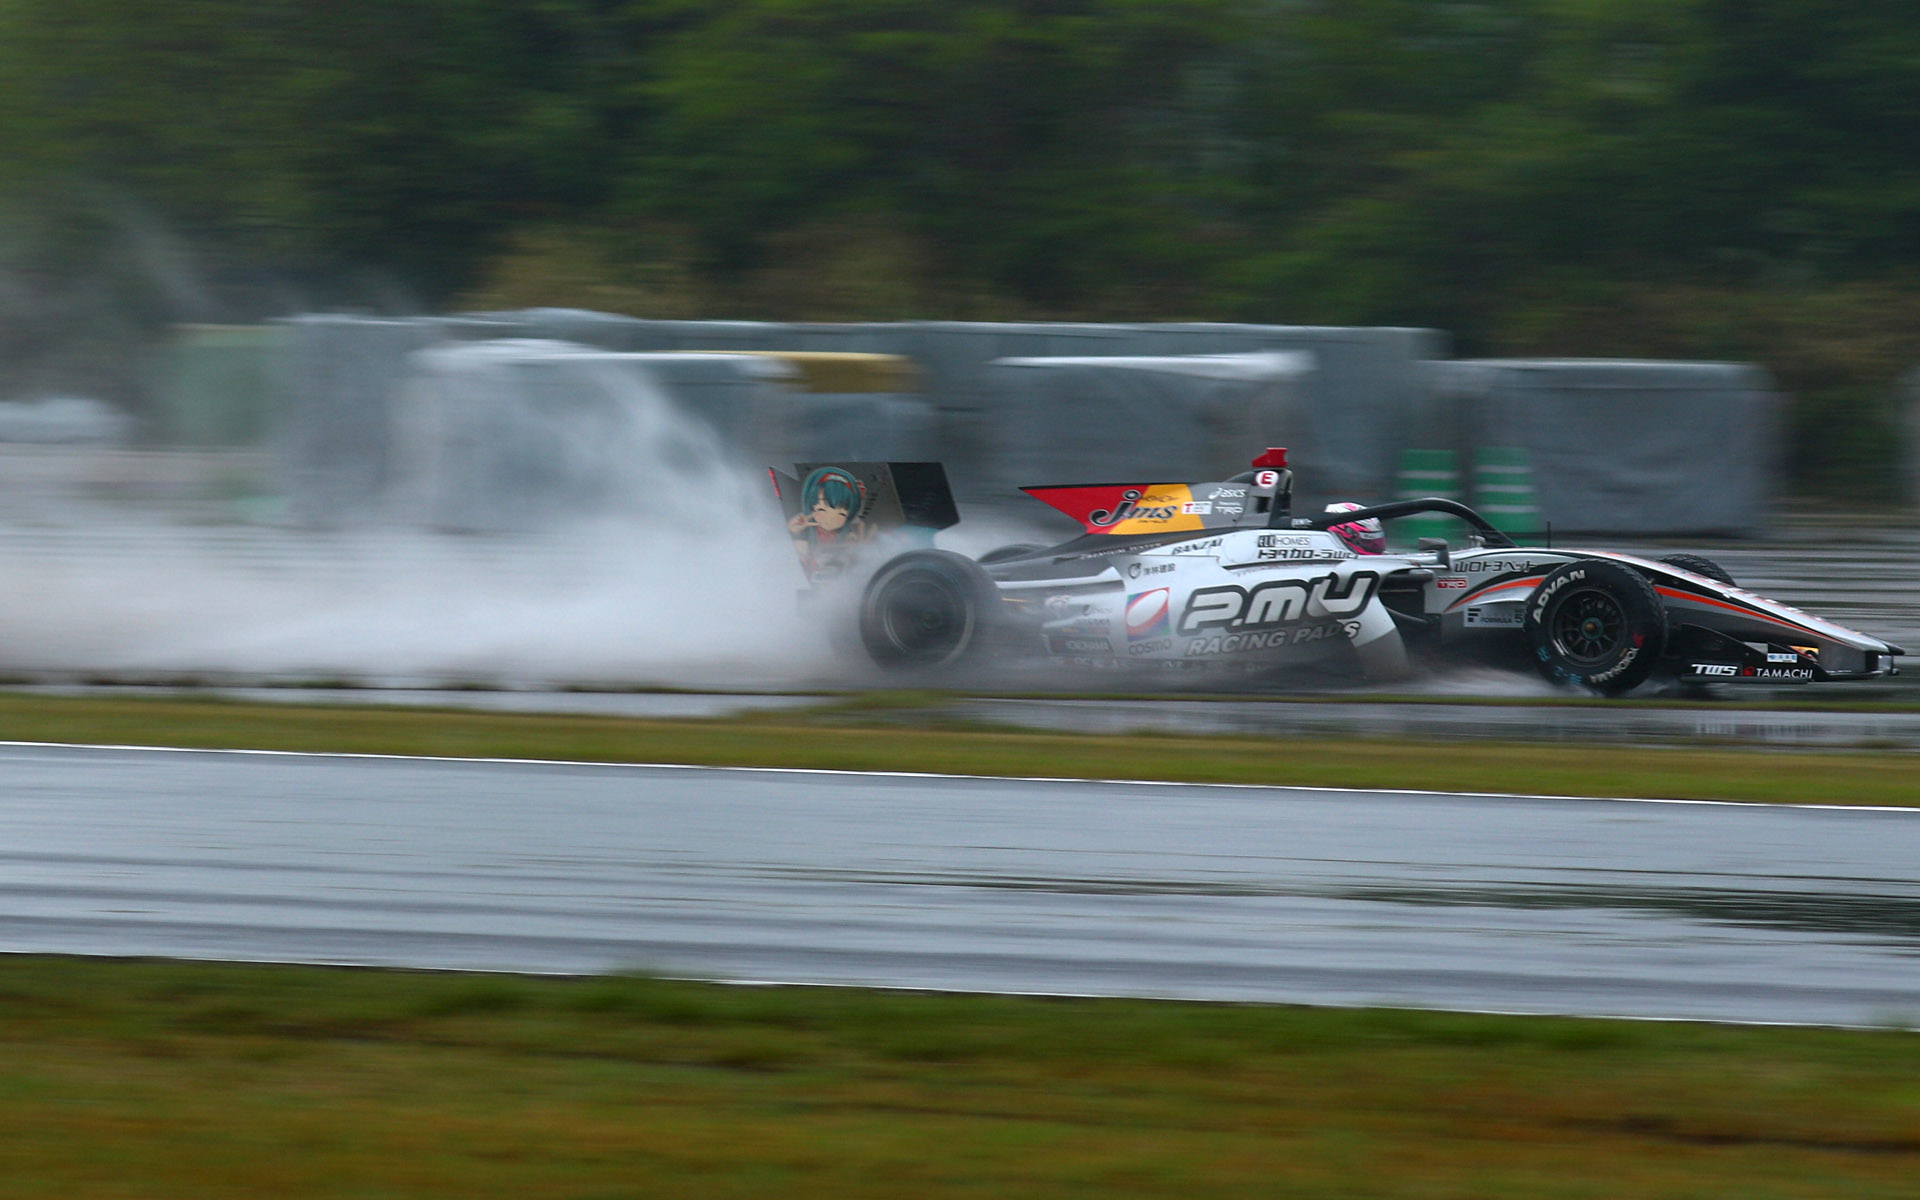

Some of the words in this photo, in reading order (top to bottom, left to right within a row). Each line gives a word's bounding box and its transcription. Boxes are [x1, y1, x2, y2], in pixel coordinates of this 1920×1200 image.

[1261, 473, 1274, 485] E
[1276, 536, 1310, 546] HOMES
[1532, 570, 1586, 624] ADVAN
[1185, 631, 1290, 657] RACING
[1291, 620, 1361, 645] PADS
[1691, 664, 1738, 676] TWS
[1756, 668, 1813, 679] TAMACHI
